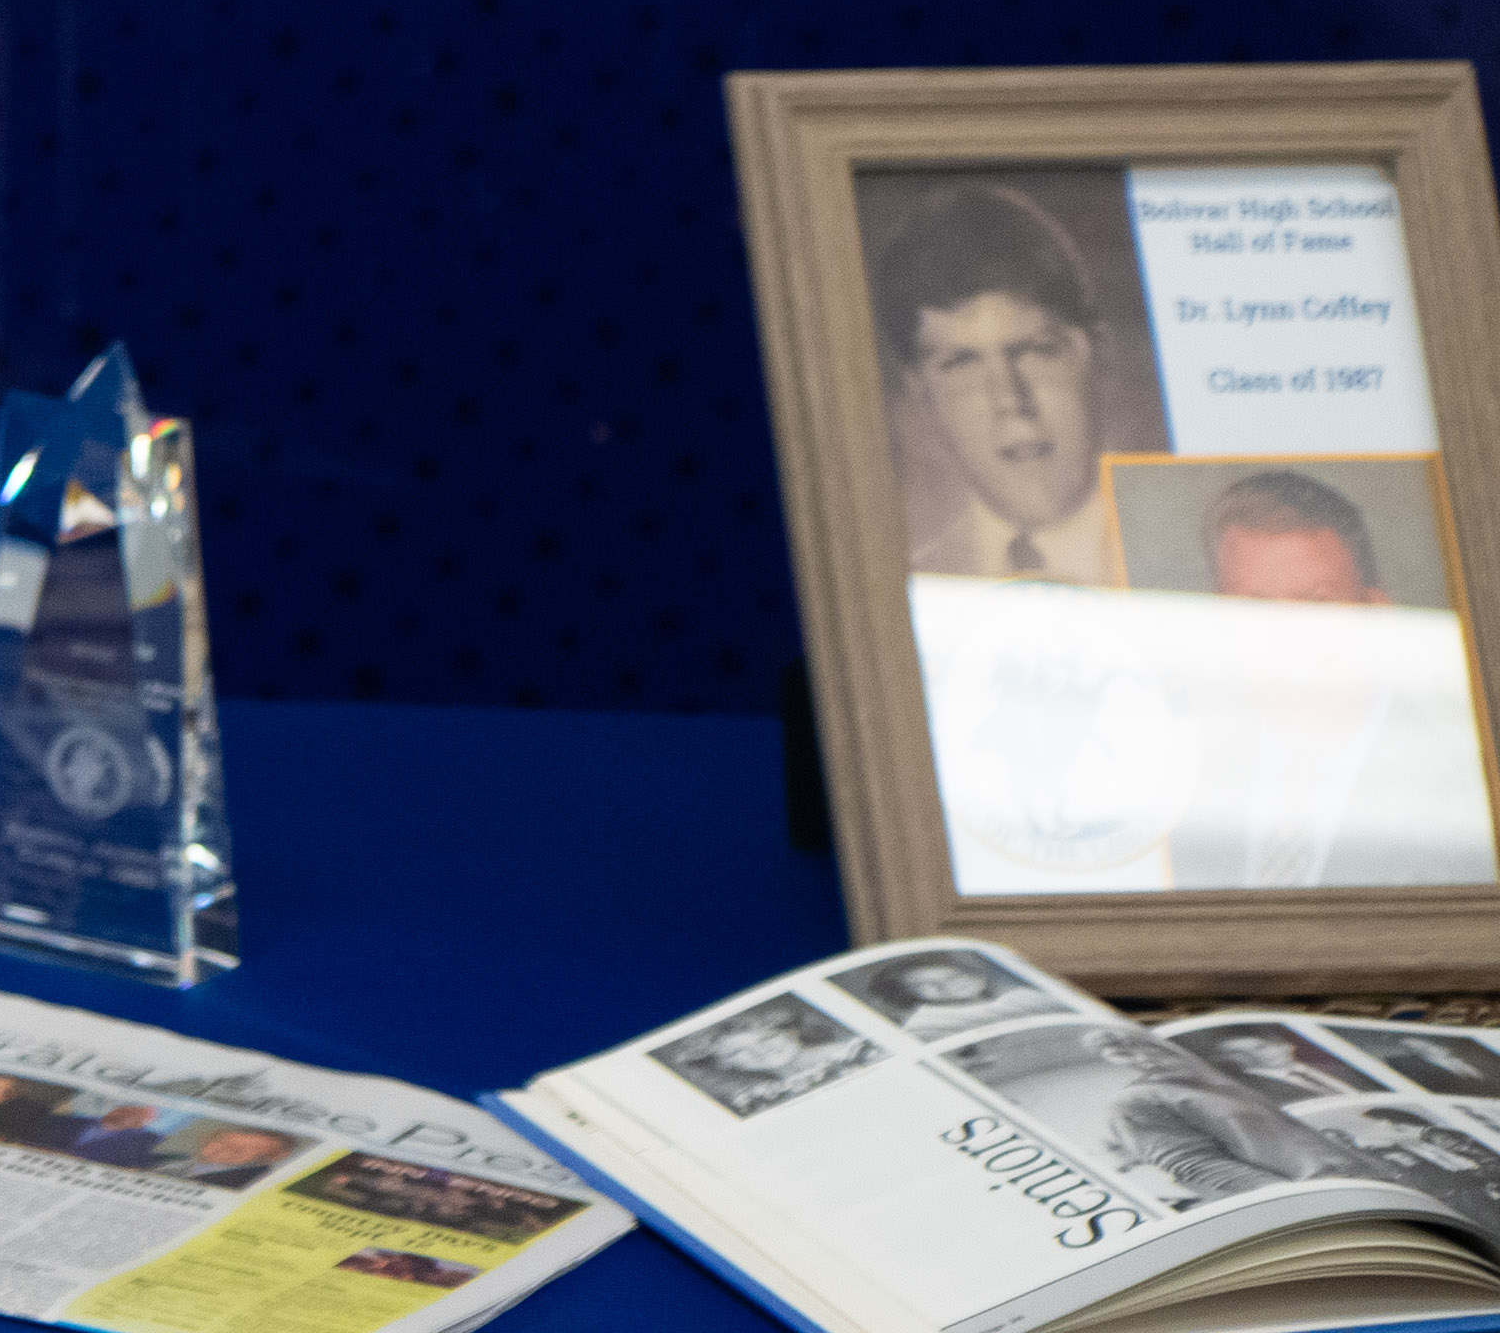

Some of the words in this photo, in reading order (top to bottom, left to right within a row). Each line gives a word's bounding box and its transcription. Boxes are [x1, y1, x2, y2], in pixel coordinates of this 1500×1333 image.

[1138, 201, 1230, 221] Bolivar
[1238, 197, 1299, 225] High
[1307, 196, 1399, 220] School
[1190, 231, 1244, 252] Hall
[1251, 231, 1277, 252] of
[1283, 230, 1354, 252] Fame
[1223, 297, 1296, 327] Lynn
[1302, 294, 1393, 326] Coffey
[1207, 367, 1283, 393] Class
[1290, 366, 1317, 392] of
[1326, 366, 1384, 392] 1987
[938, 1115, 1147, 1250] Seniors
